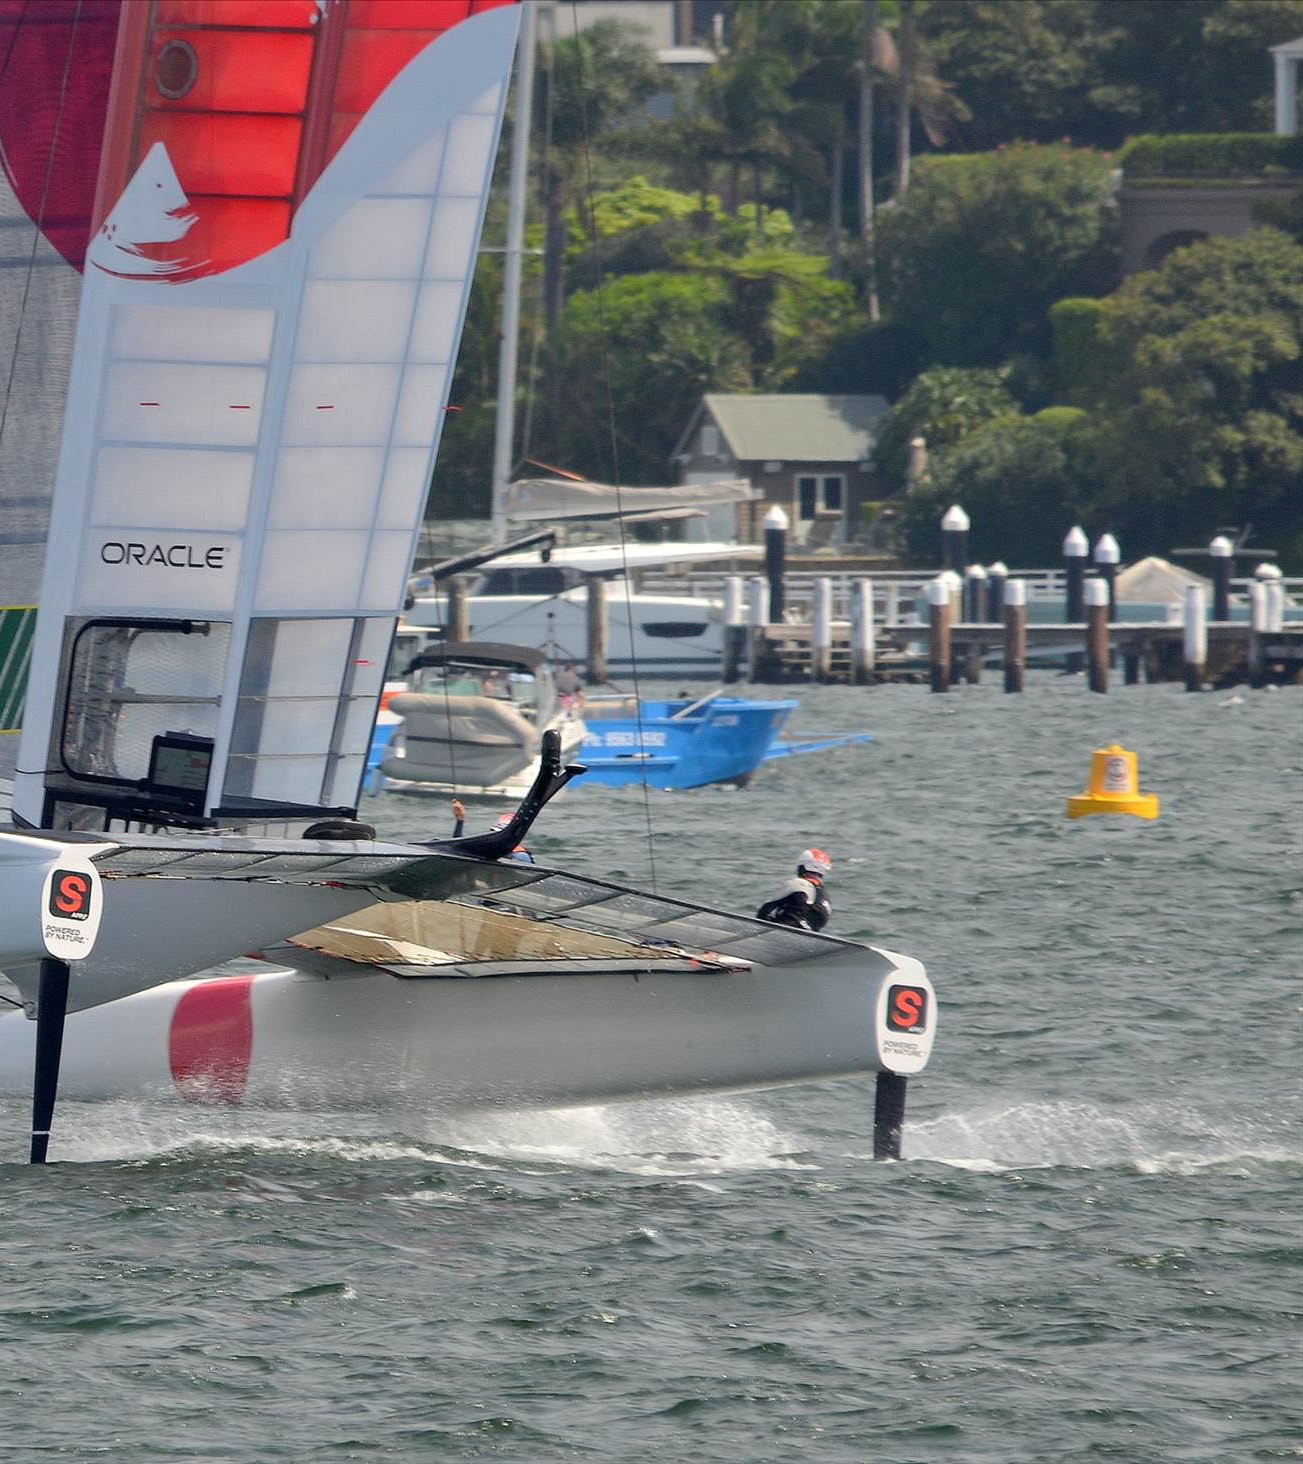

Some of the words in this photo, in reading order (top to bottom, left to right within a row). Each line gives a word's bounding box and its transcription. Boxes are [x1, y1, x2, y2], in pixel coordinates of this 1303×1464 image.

[101, 542, 225, 569] ORACLE
[55, 875, 88, 913] S
[45, 924, 81, 936] POWERED
[892, 990, 922, 1027] S
